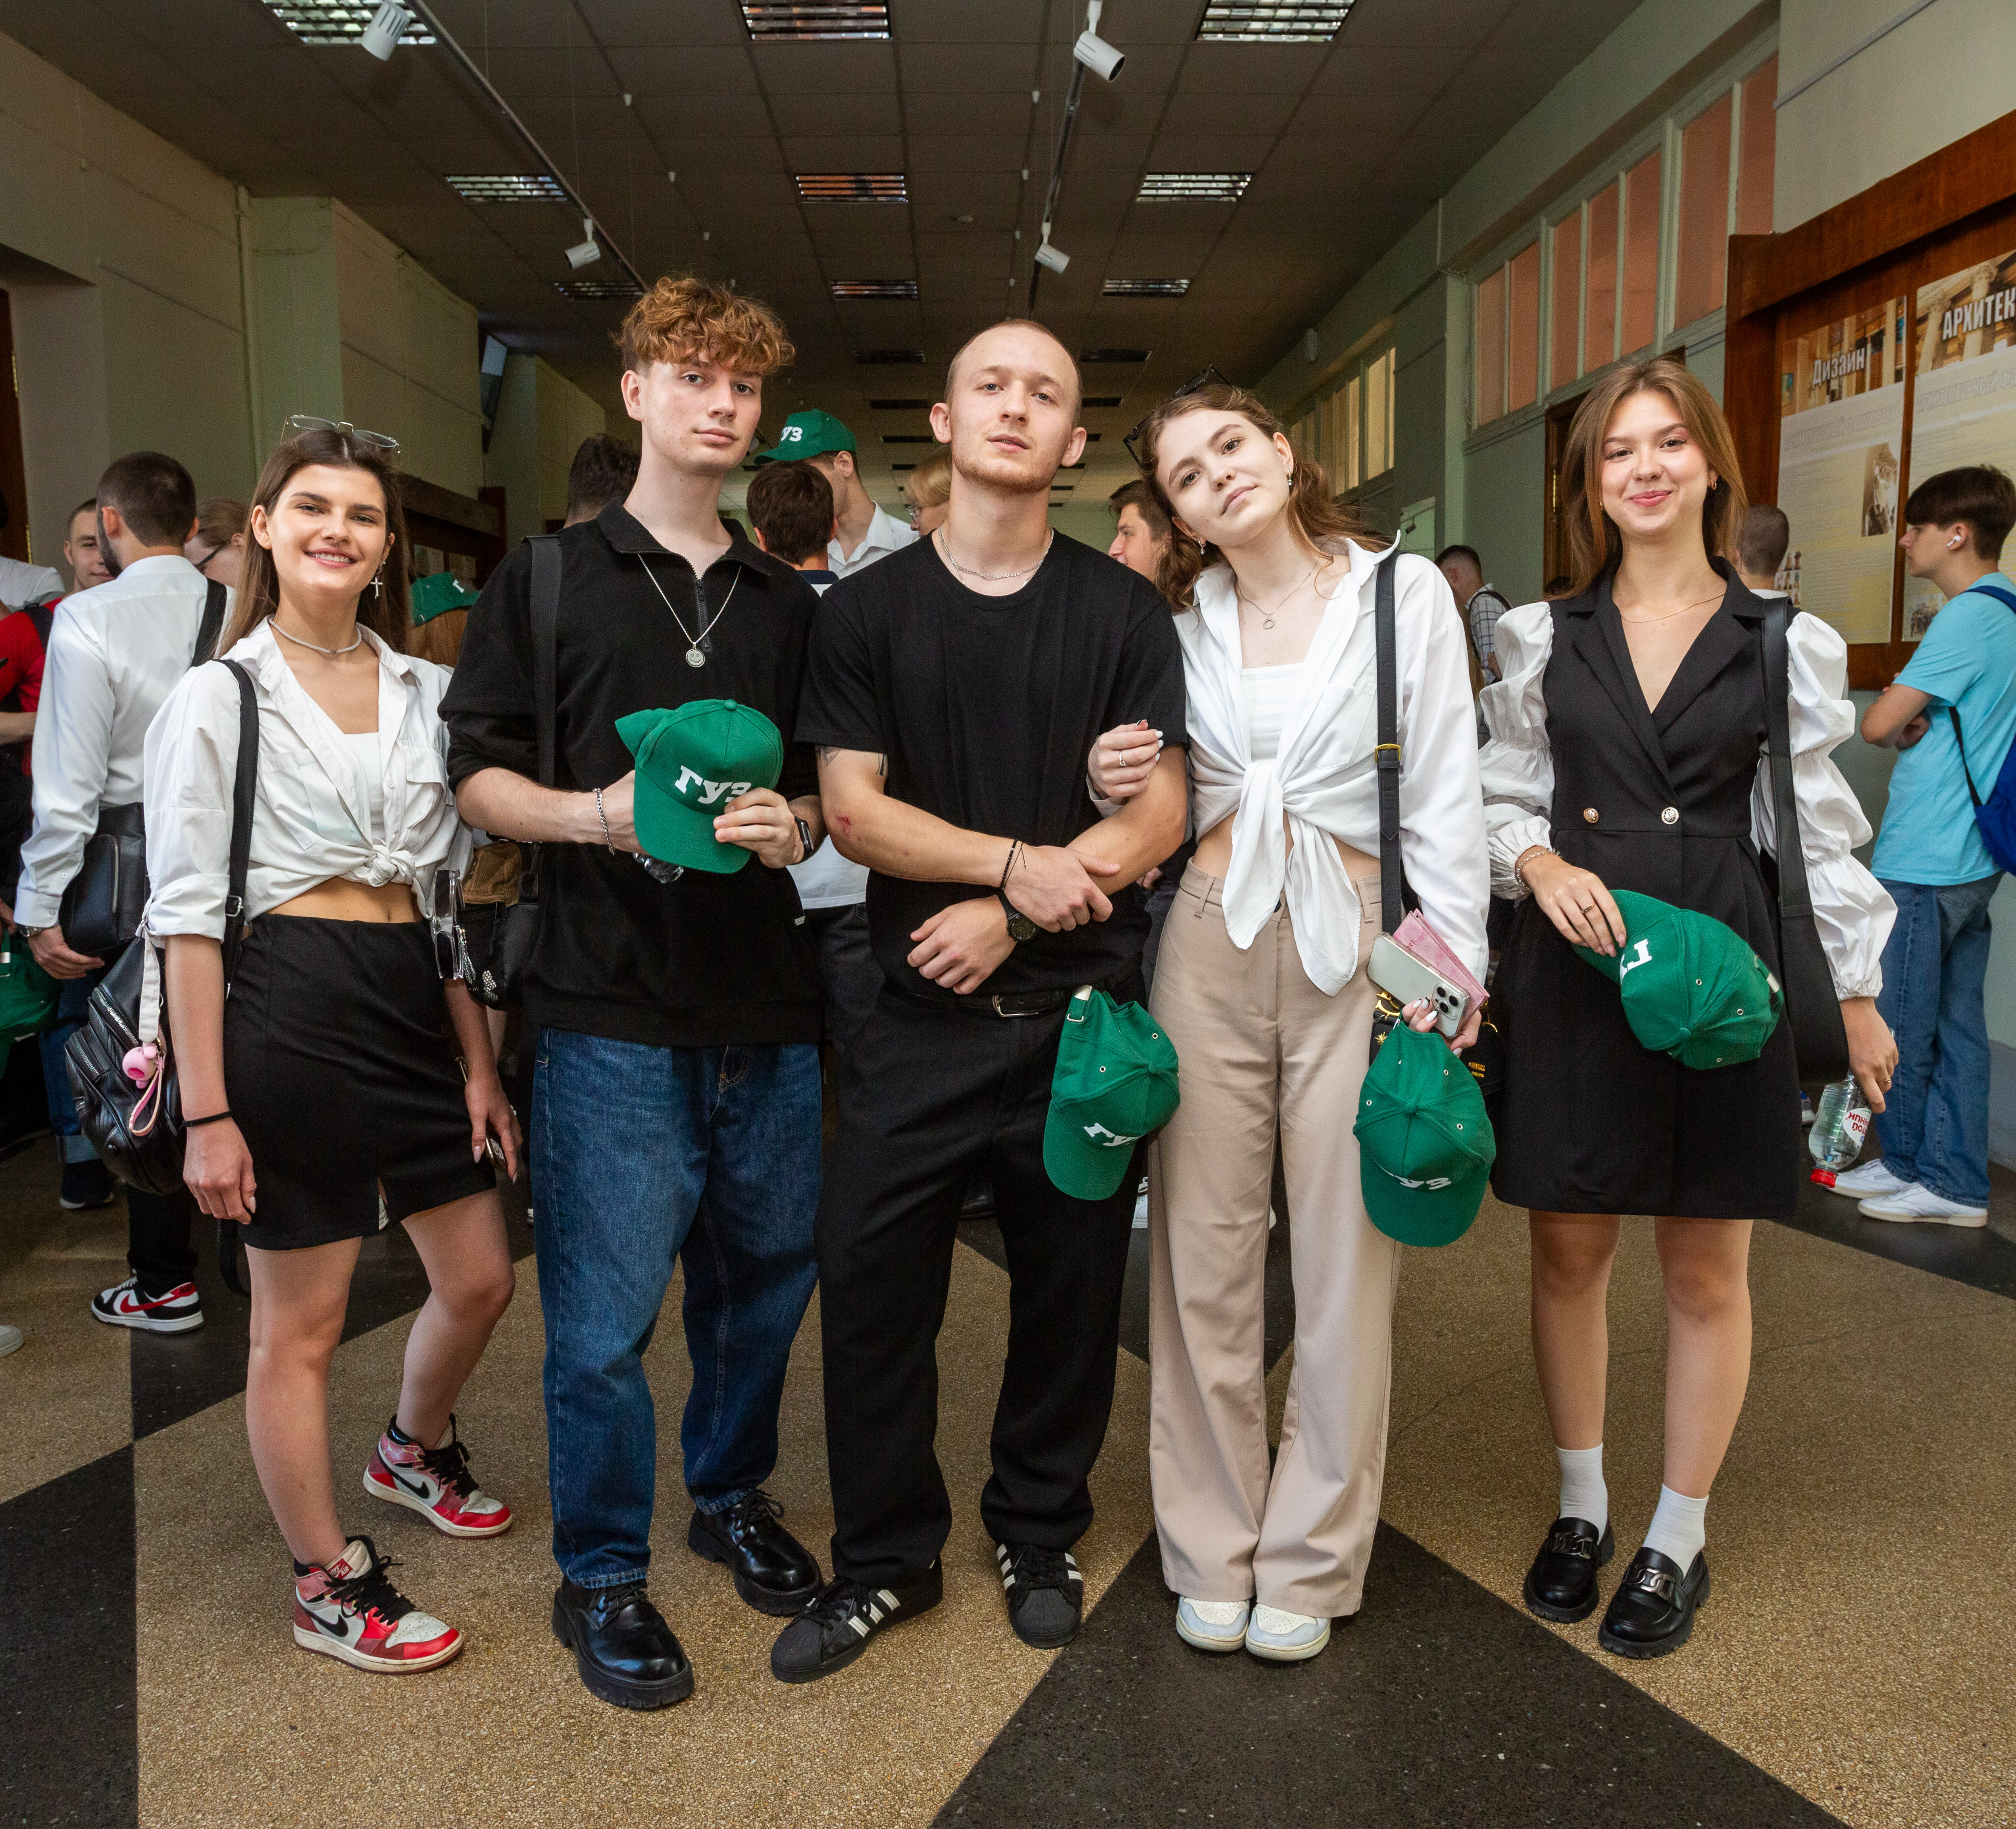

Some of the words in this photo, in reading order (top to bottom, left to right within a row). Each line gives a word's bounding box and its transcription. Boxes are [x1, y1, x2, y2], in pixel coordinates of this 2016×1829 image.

[1943, 287, 2016, 340] АРХИТЕК
[1812, 345, 1865, 389] Дизайн
[781, 426, 803, 442] УЗ
[1083, 1122, 1138, 1146] ГУ
[341, 1566, 350, 1576] AIR
